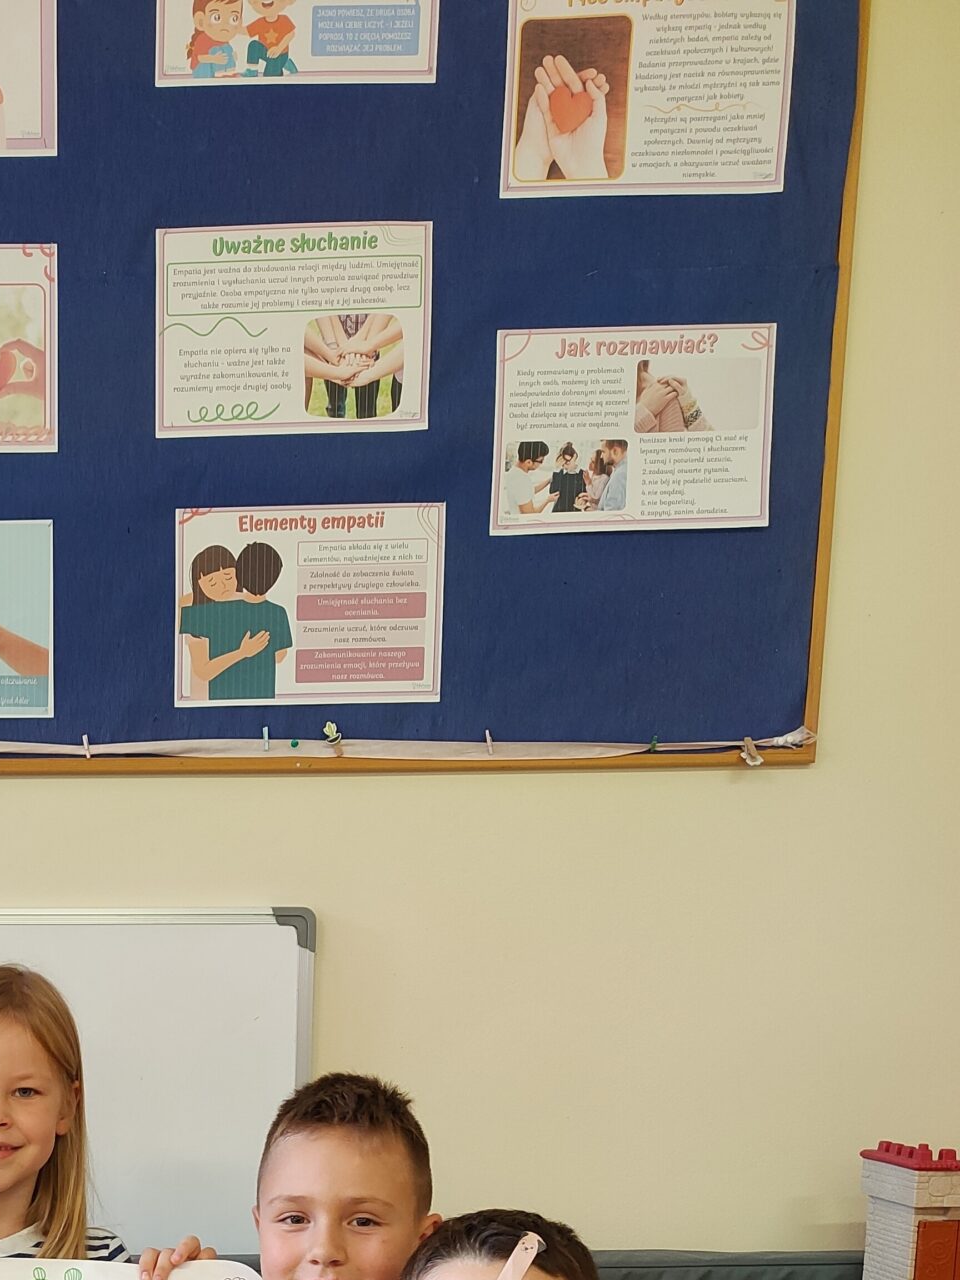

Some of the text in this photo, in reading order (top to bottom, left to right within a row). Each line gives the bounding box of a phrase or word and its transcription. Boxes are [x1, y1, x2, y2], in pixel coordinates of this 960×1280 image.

[212, 230, 378, 256] Uważne słuchanie
[179, 348, 208, 358] Empatia
[224, 347, 247, 356] opiera
[249, 346, 259, 356] się
[261, 346, 280, 355] tylko
[556, 334, 718, 358] Jak rozmawiać?
[238, 512, 385, 534] Elementy empatii
